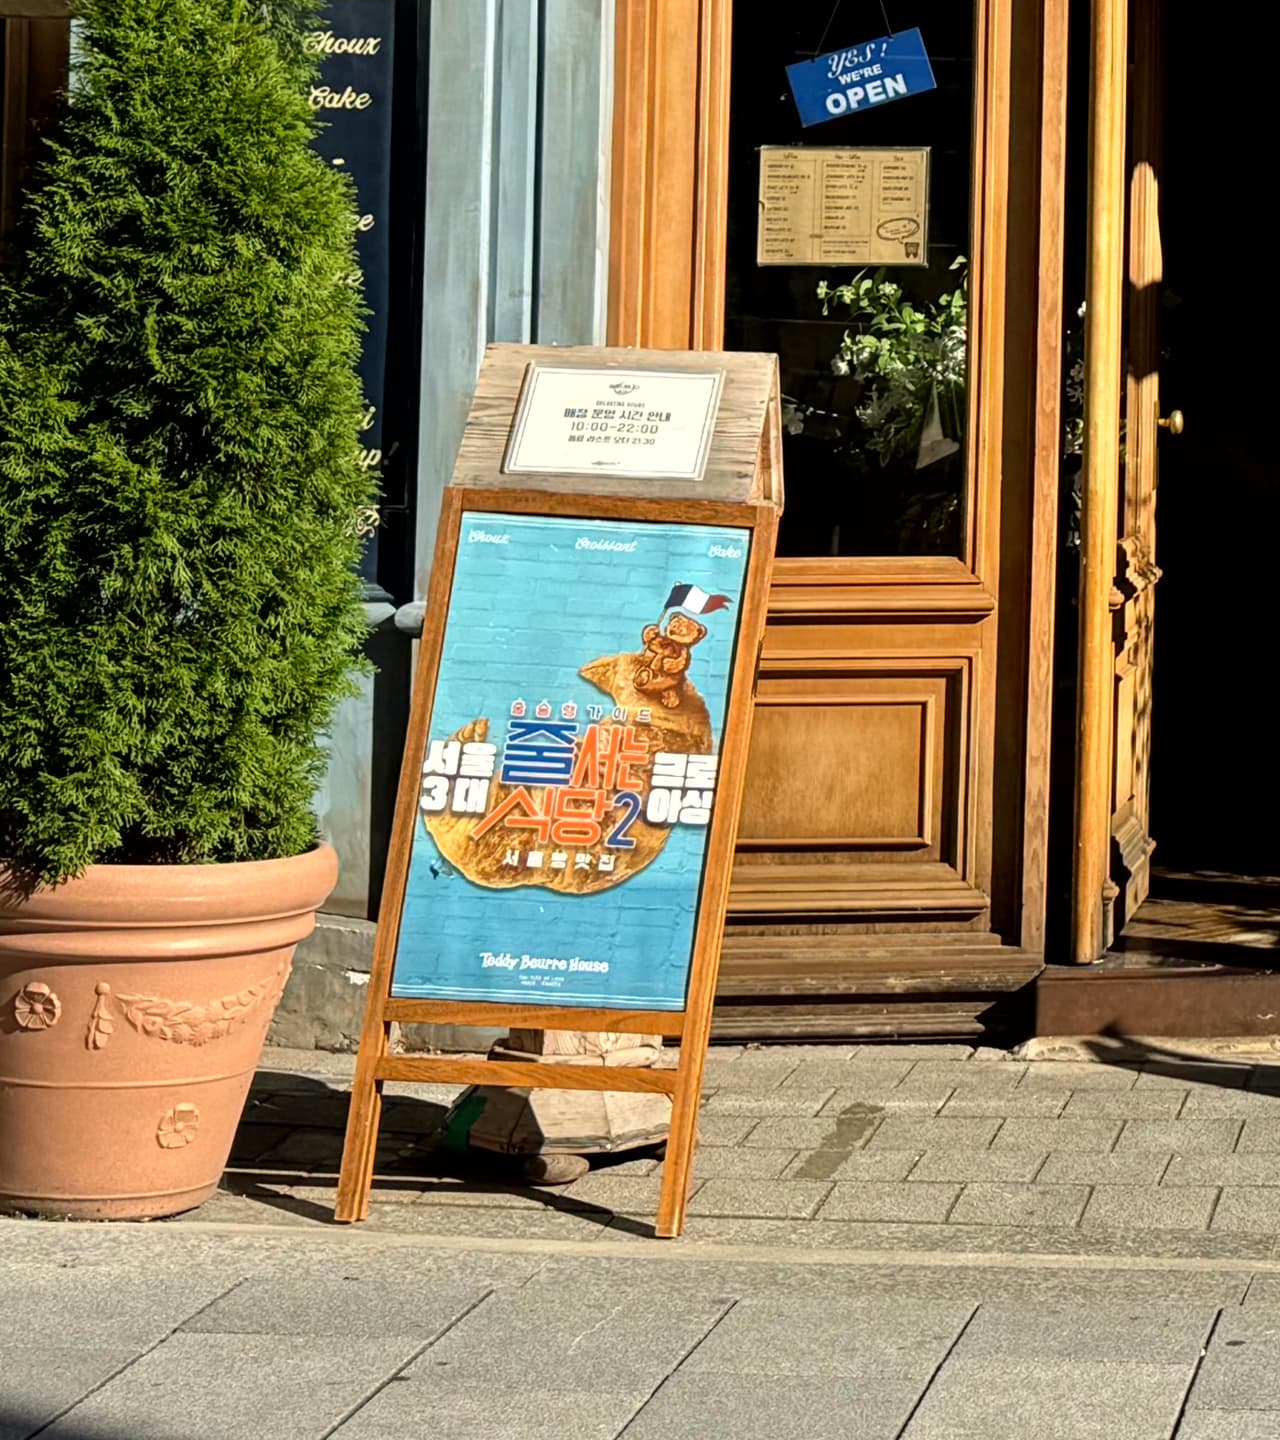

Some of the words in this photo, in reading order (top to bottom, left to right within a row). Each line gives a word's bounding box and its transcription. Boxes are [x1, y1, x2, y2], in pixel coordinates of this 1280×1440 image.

[838, 63, 883, 86] WE'RE
[307, 85, 373, 109] Cake
[825, 73, 908, 115] OPEN
[619, 410, 644, 421] 시간
[646, 411, 672, 422] 안내
[571, 421, 659, 435] 10:00-22:00
[575, 536, 638, 553] Croissant
[587, 704, 653, 722] 가이드
[422, 740, 497, 778] 서울
[480, 952, 520, 971] Teddy
[519, 954, 568, 971] Beurre
[567, 957, 609, 973] House
